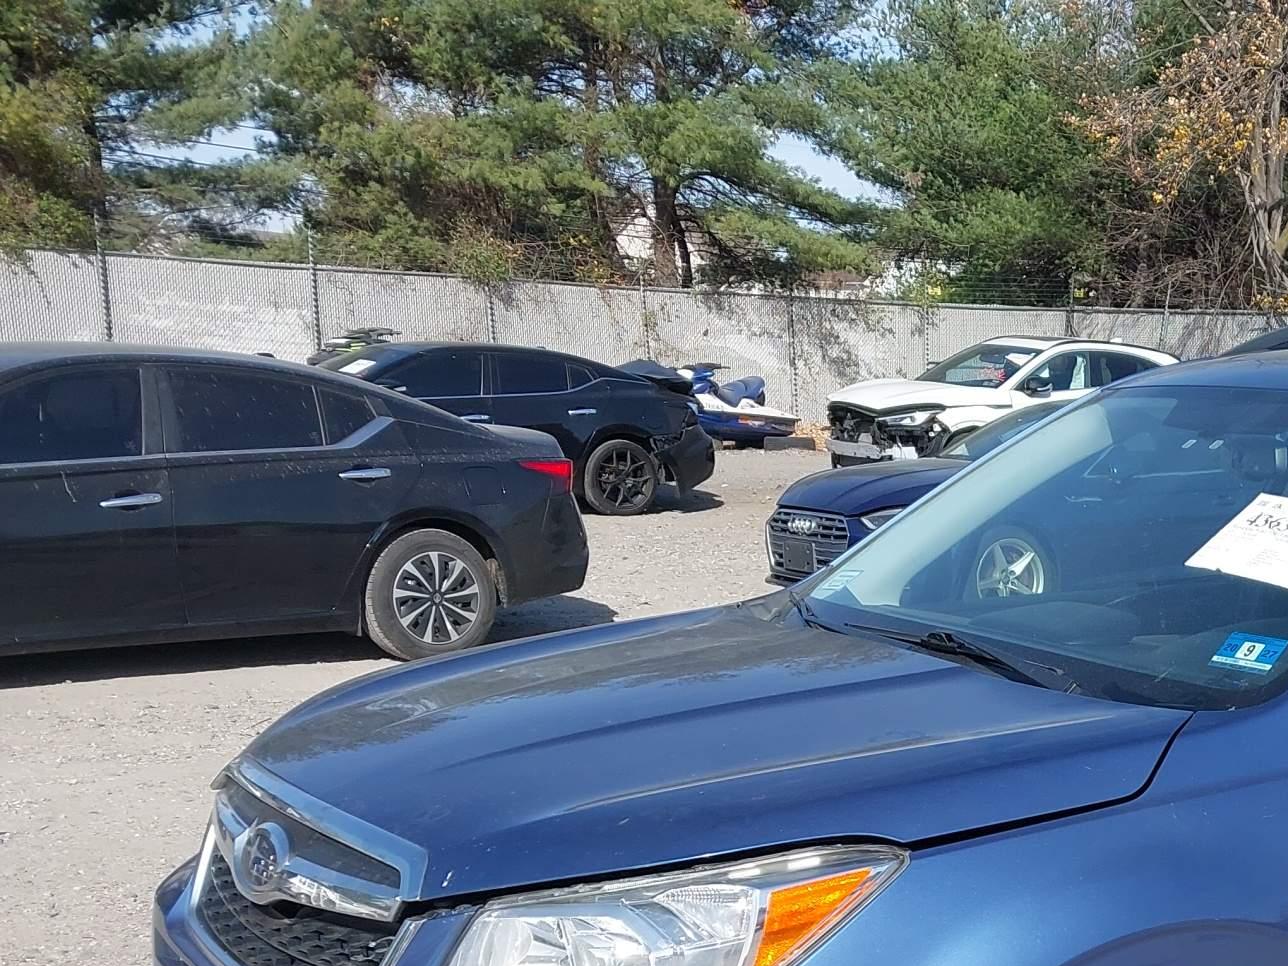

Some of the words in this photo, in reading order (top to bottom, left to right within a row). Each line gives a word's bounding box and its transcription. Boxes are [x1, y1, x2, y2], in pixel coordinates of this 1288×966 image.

[1223, 643, 1239, 652] 20
[1243, 644, 1257, 657] 9
[1261, 650, 1278, 659] 27
